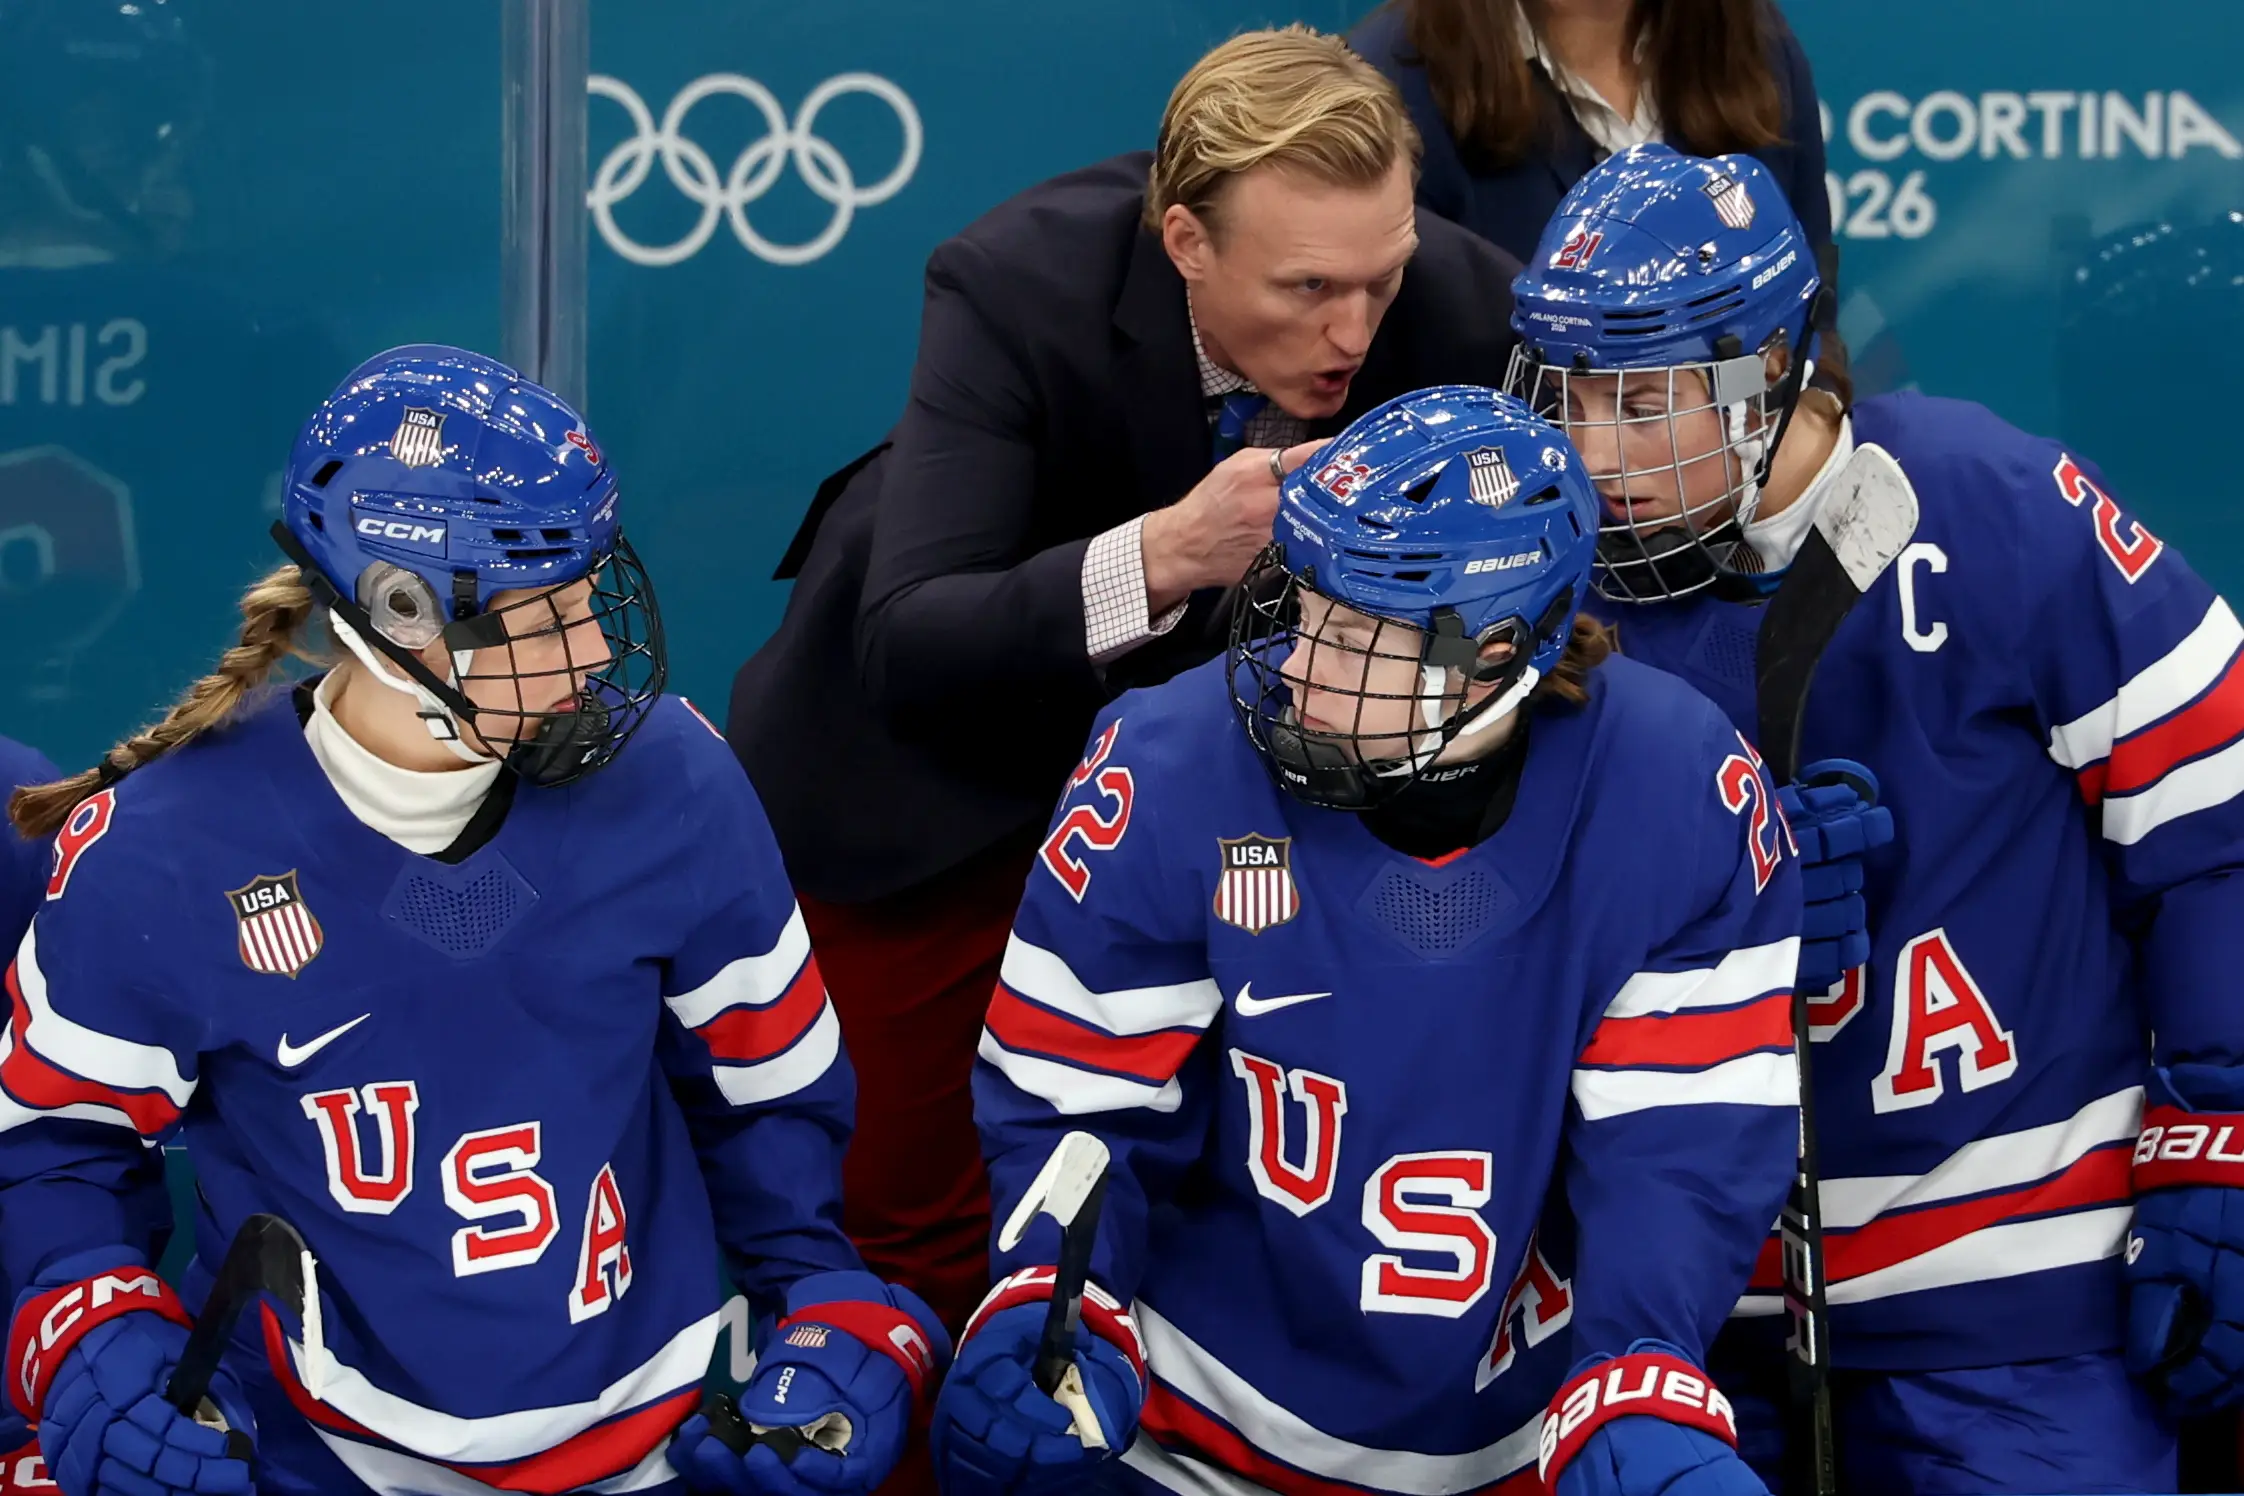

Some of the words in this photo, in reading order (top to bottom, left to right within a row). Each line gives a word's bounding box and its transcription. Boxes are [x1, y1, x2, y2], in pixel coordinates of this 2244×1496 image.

[1847, 90, 2244, 160] CORTINA
[1707, 178, 1731, 198] USA
[1550, 229, 1604, 270] 21
[1752, 250, 1796, 290] BAUER
[1529, 311, 1558, 323] MILANO
[1558, 314, 1594, 327] CORTINA
[408, 411, 436, 427] USA
[1471, 452, 1500, 466] USA
[357, 518, 446, 543] CCM
[1464, 551, 1541, 574] BAUER
[1898, 543, 1948, 652] C
[1038, 717, 1135, 905] 22
[1232, 846, 1278, 866] USA
[241, 883, 290, 914] USA
[299, 1080, 633, 1325] USA
[21, 1275, 161, 1407] CCM
[774, 1367, 796, 1404] CCM
